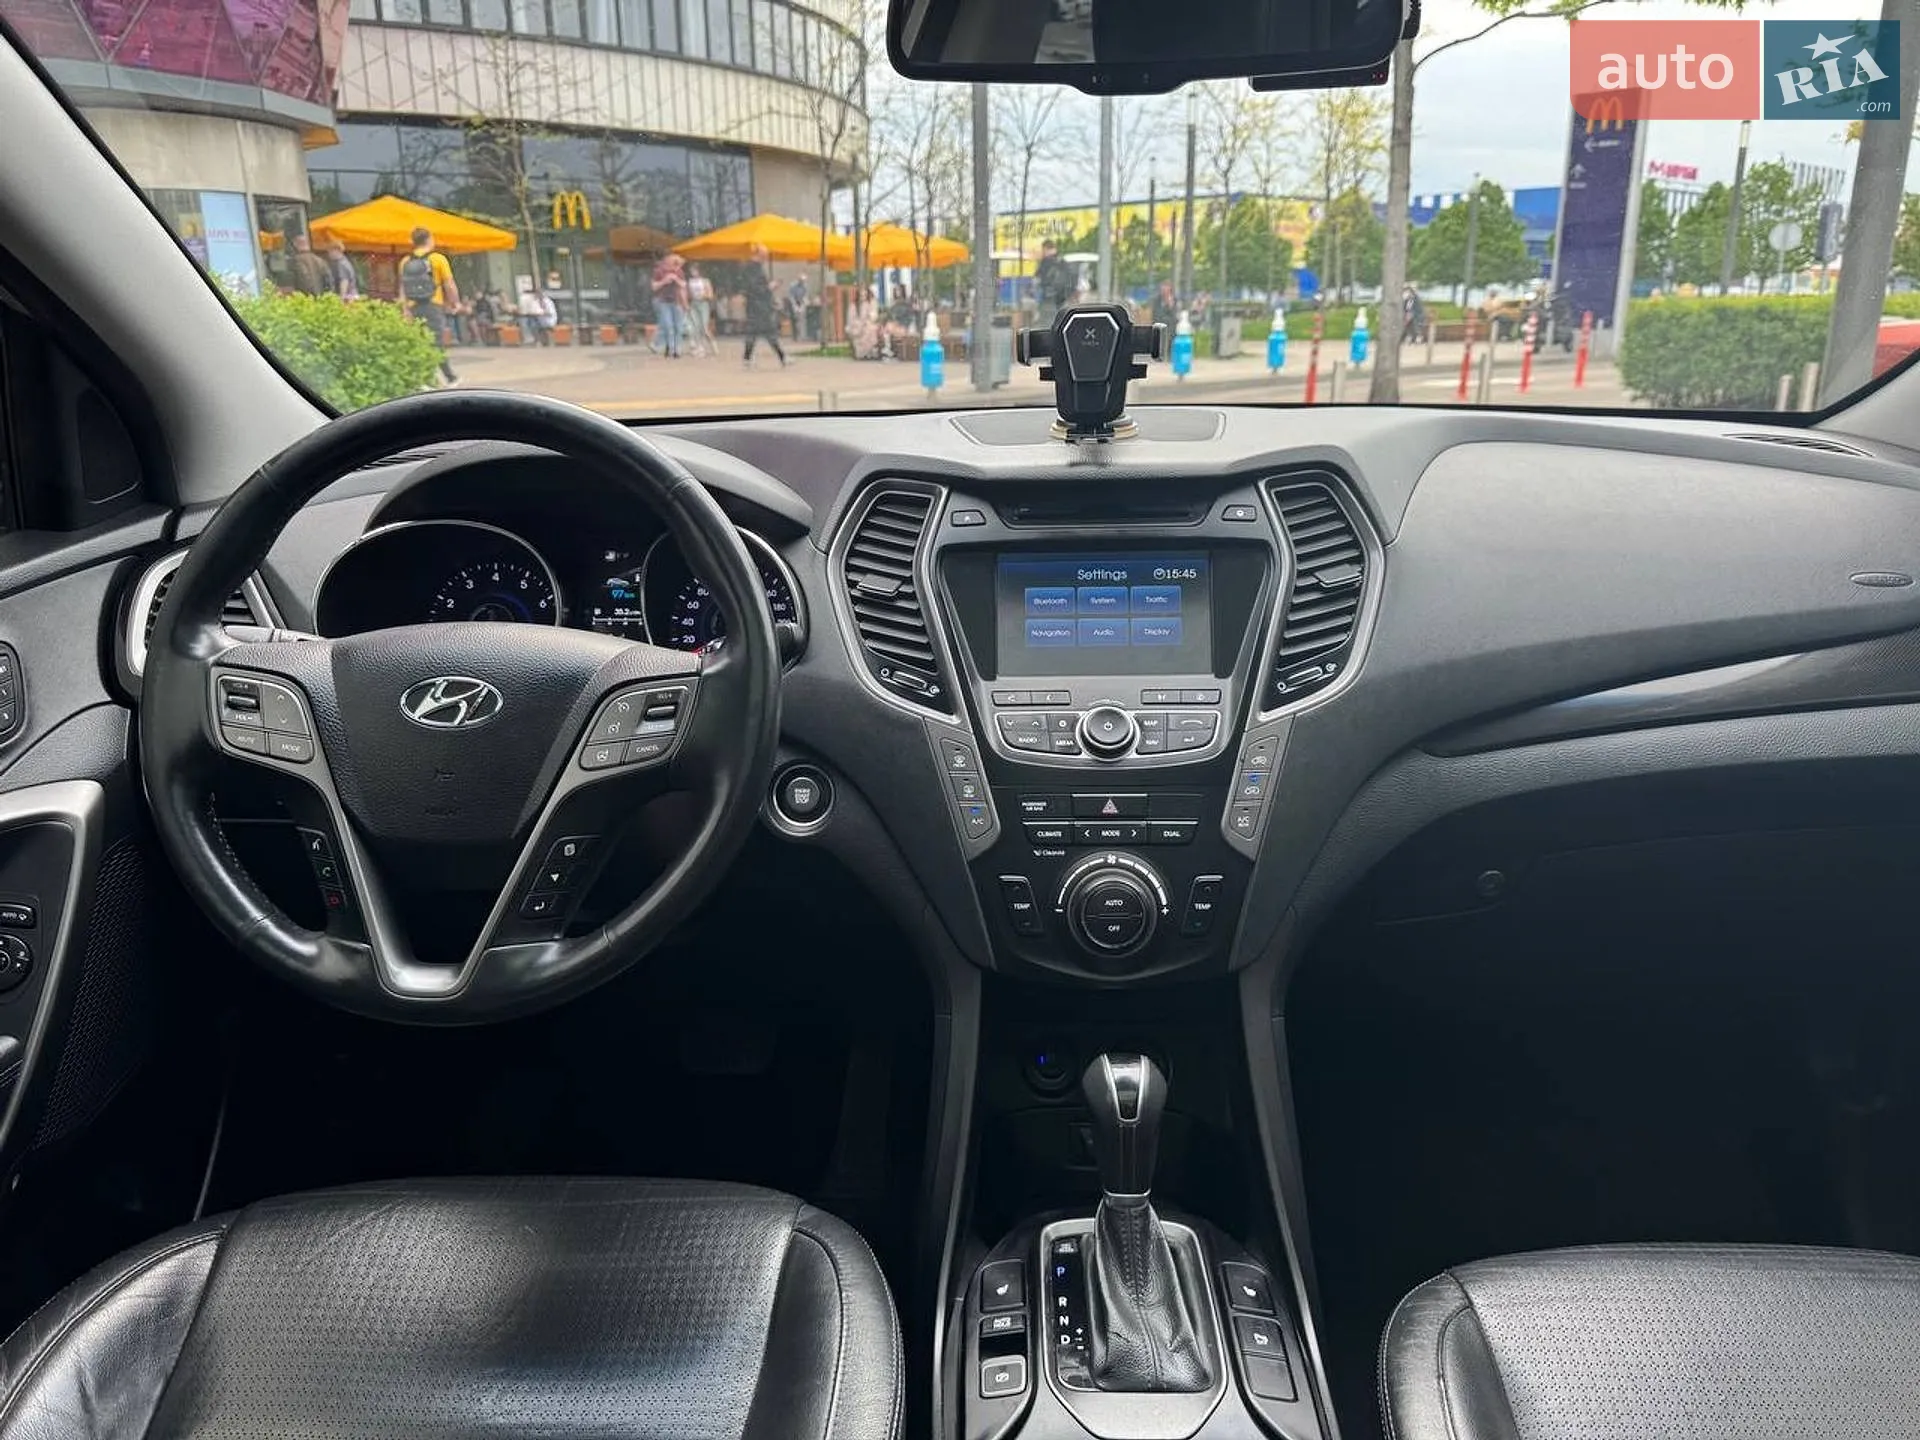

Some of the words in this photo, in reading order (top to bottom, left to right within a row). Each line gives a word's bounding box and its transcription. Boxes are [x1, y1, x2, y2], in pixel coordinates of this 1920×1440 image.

[491, 572, 500, 582] 4
[1078, 568, 1128, 581] Settings
[1167, 569, 1197, 580] 15:45
[465, 579, 475, 590] 3
[520, 579, 528, 590] 5
[446, 598, 455, 609] 2
[539, 599, 548, 609] 6
[1033, 597, 1069, 606] Bluetooth
[1091, 597, 1117, 606] System
[1145, 595, 1169, 604] Traffic
[686, 601, 699, 610] 60
[682, 618, 694, 627] 40
[1031, 629, 1071, 638] Navigation
[1093, 628, 1116, 637] Audio
[1144, 629, 1172, 637] Display
[682, 635, 696, 643] 20
[1101, 829, 1120, 837] MODE
[1013, 902, 1031, 910] TEMP
[1194, 902, 1211, 910] TEMP
[1107, 924, 1121, 932] OFF
[1056, 1266, 1065, 1278] P
[1058, 1296, 1068, 1308] R
[1059, 1315, 1070, 1327] N
[1060, 1334, 1071, 1345] D
